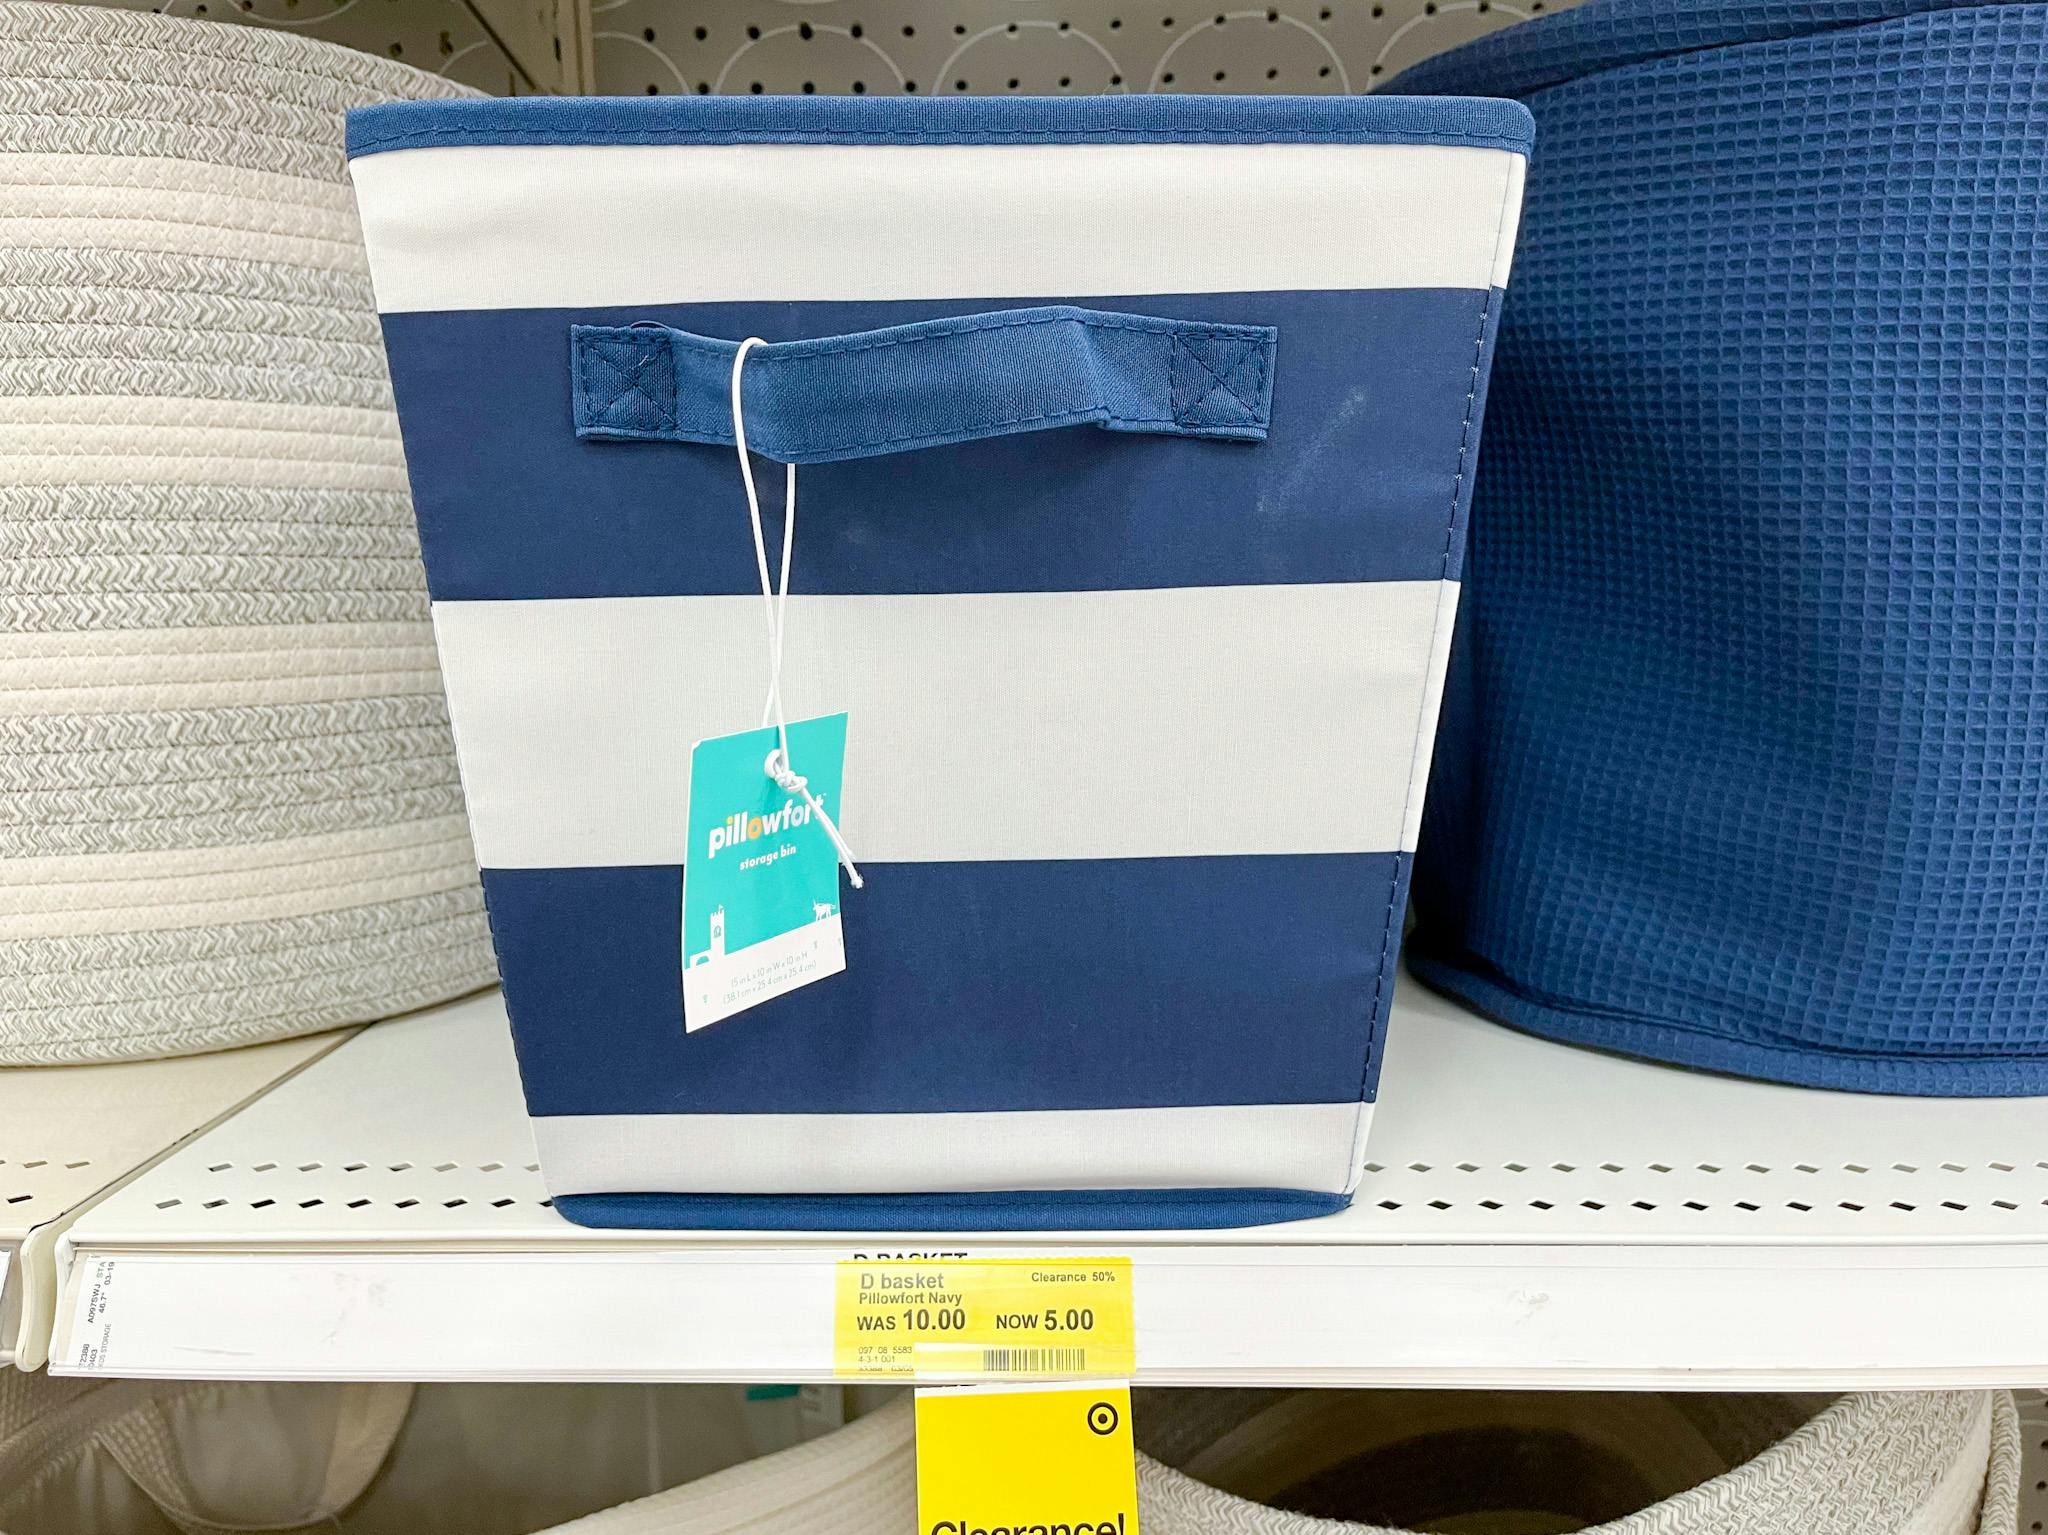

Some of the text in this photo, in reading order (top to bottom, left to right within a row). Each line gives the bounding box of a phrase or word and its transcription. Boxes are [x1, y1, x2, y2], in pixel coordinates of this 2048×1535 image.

[739, 843, 797, 871] storage bin
[861, 1272, 944, 1289] D basket
[1031, 1271, 1115, 1282] Clearance 50%
[859, 1292, 962, 1306] Pillowfort Navy
[857, 1309, 966, 1331] WAS 10.00
[996, 1309, 1094, 1330] NOW 5.00
